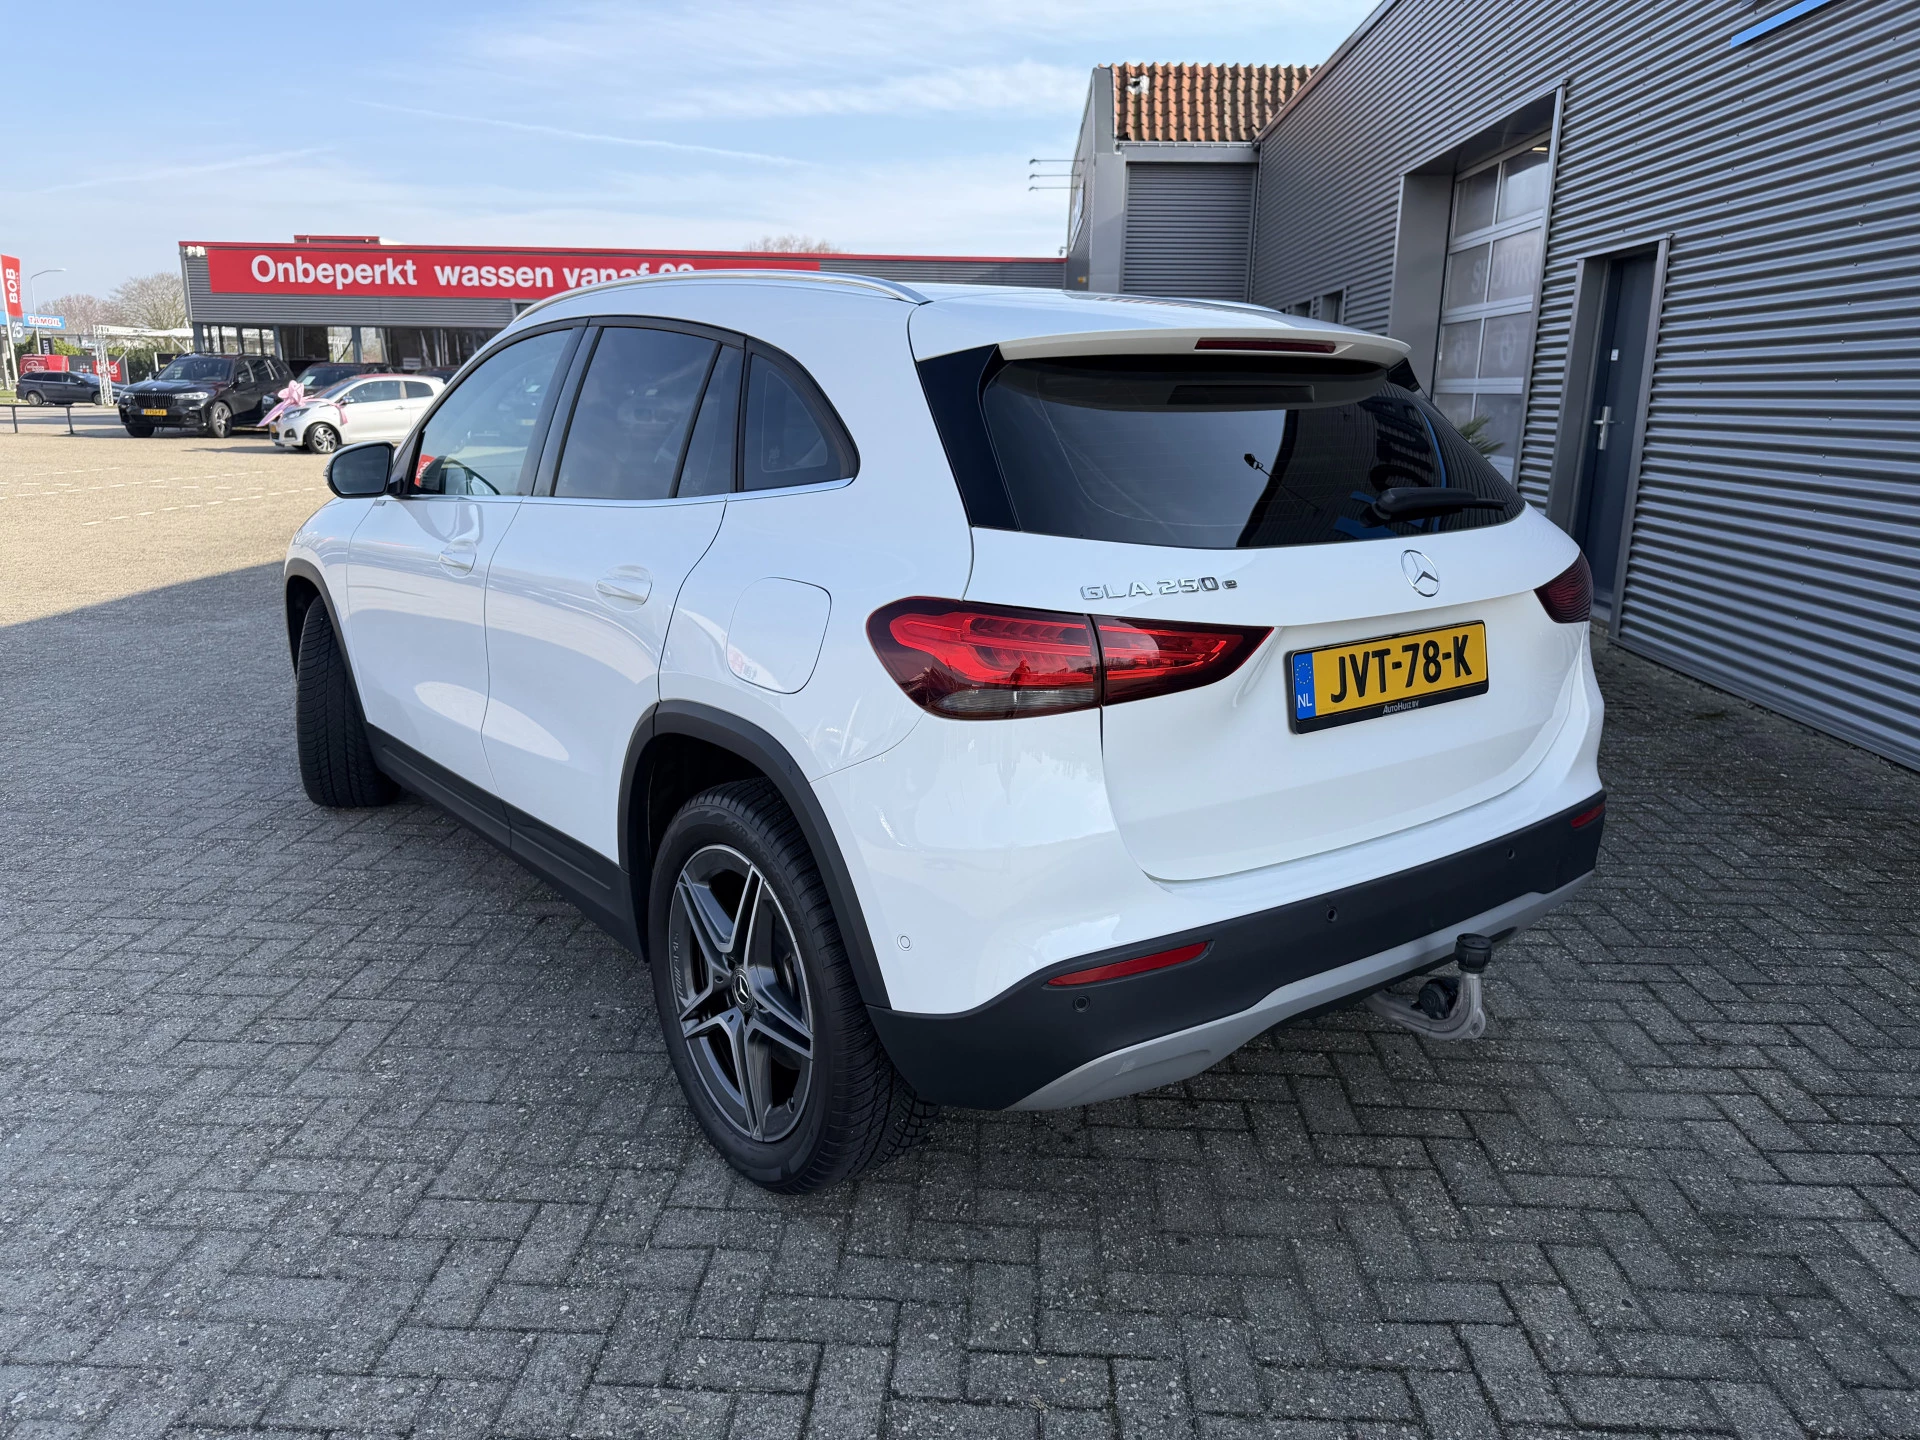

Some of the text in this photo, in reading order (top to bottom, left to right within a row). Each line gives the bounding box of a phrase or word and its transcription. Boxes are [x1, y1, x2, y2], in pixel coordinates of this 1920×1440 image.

[6, 268, 18, 304] BOB
[251, 255, 417, 289] Onbeperkt
[434, 264, 554, 288] wassen
[28, 316, 61, 326] TAMOIL
[1080, 576, 1237, 600] GLA 250 e
[1331, 635, 1472, 703] JVT-78-K
[1297, 693, 1312, 708] NL
